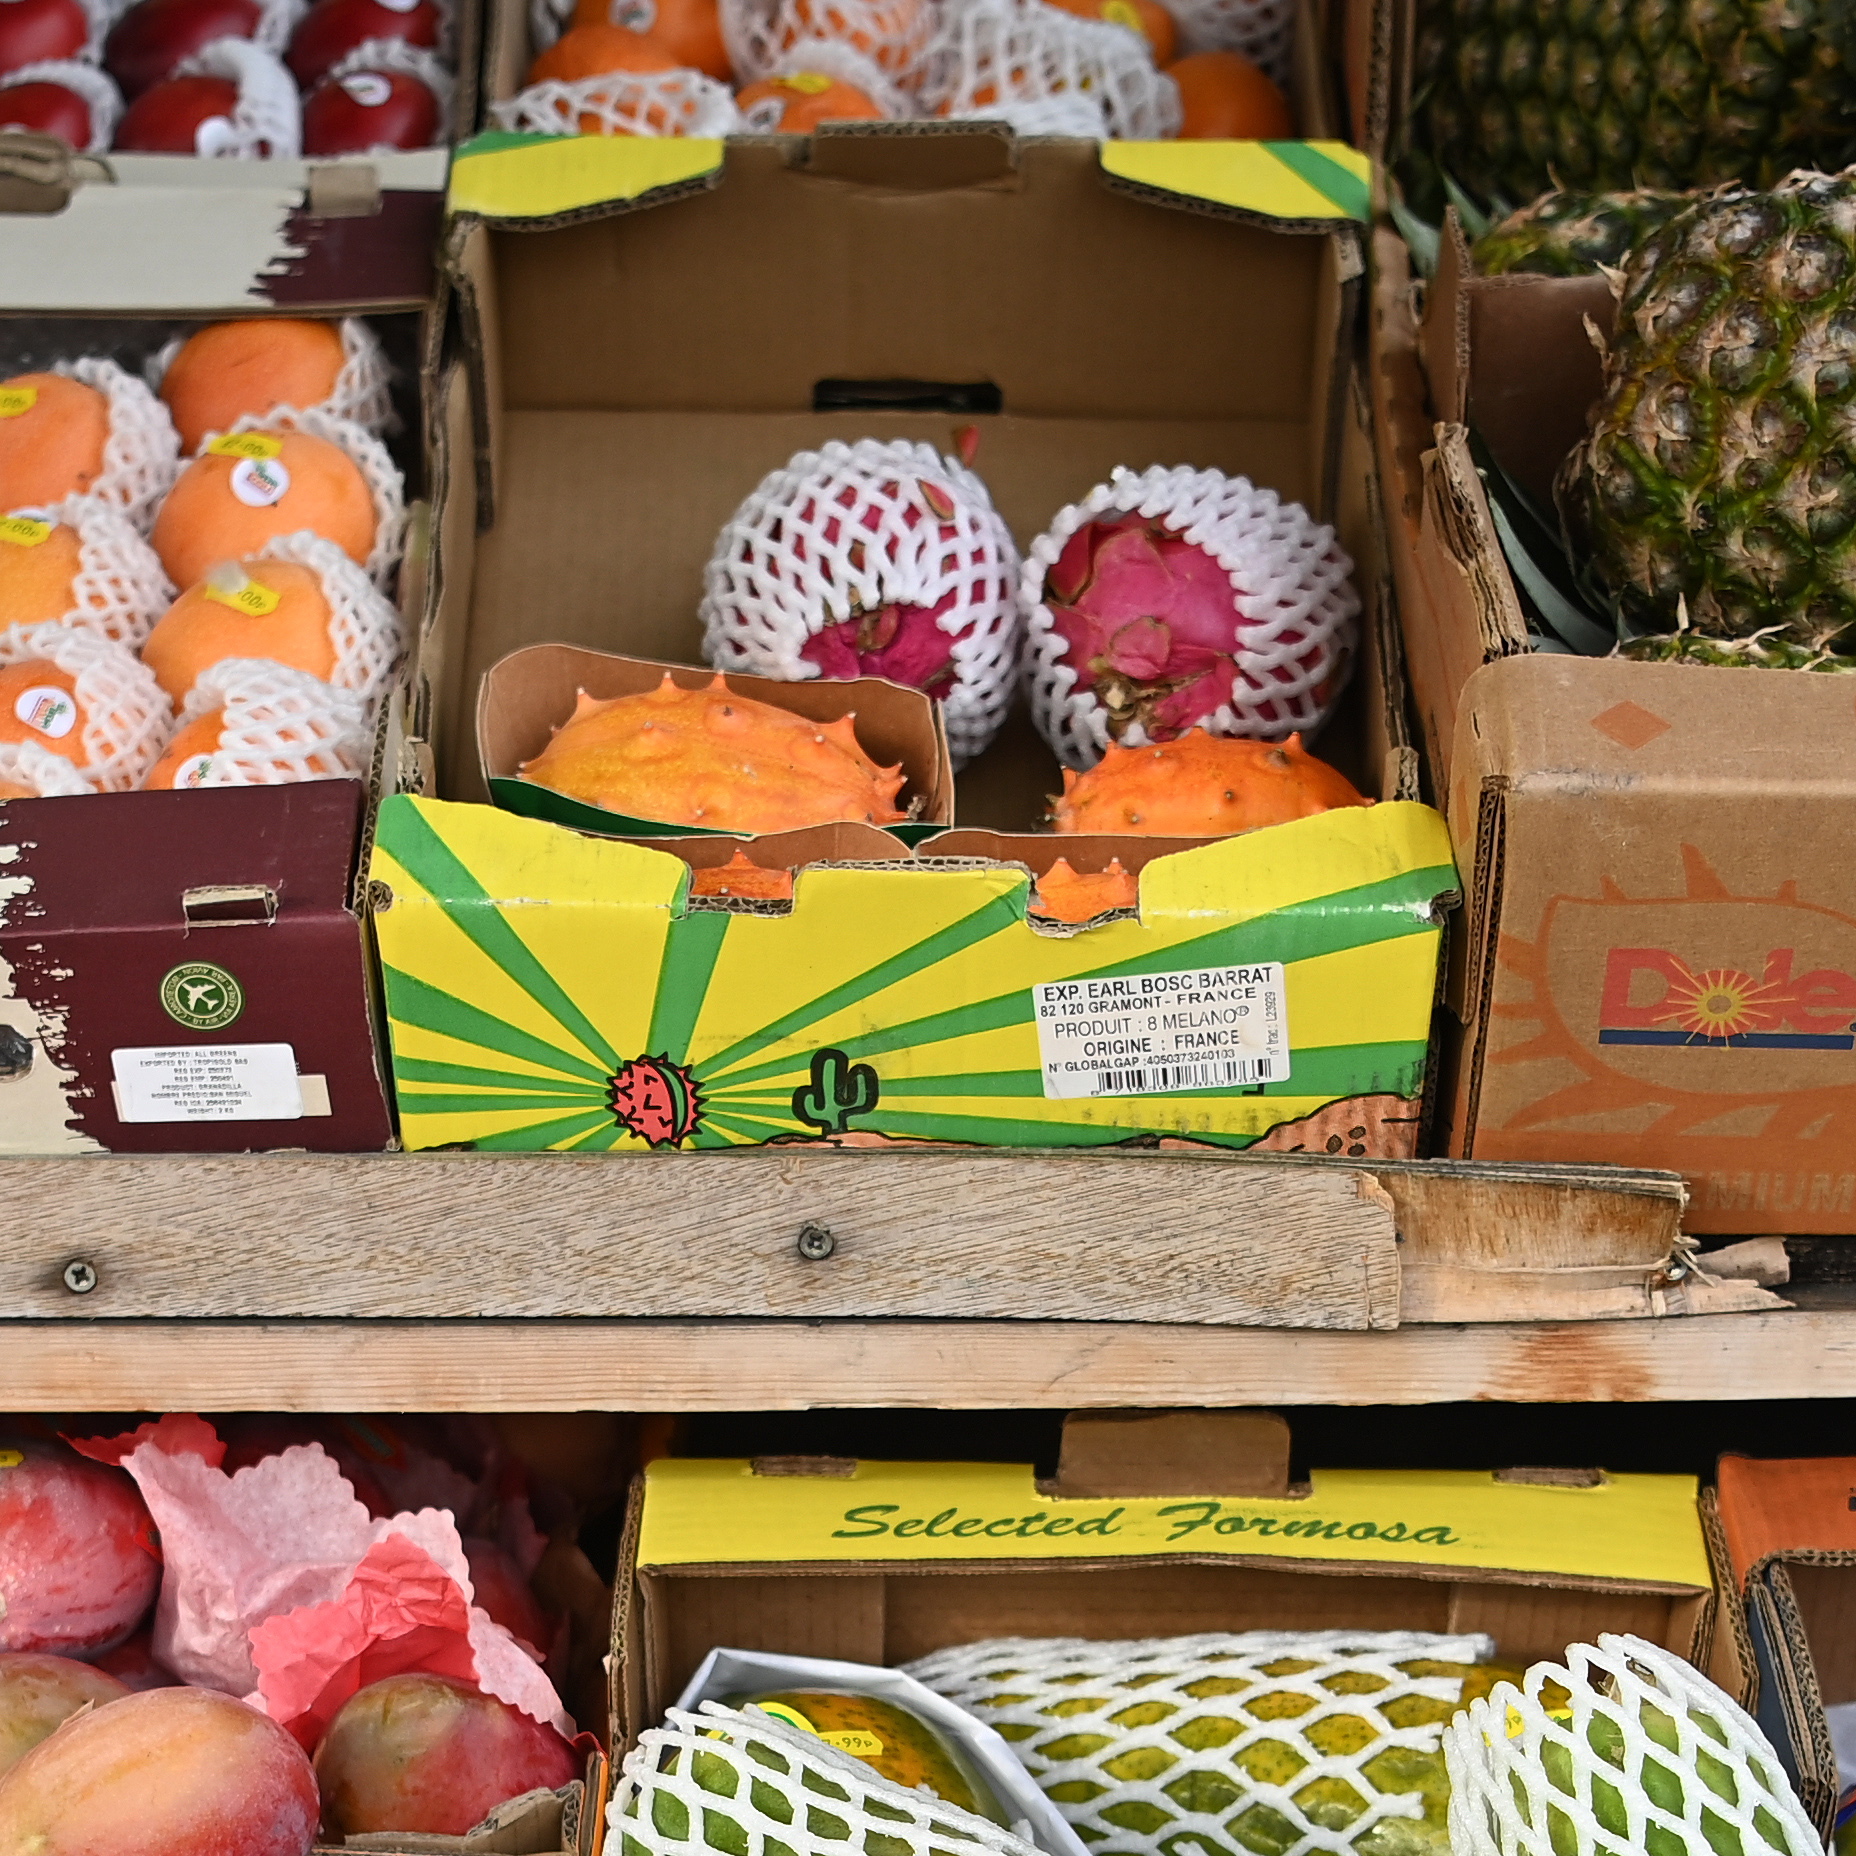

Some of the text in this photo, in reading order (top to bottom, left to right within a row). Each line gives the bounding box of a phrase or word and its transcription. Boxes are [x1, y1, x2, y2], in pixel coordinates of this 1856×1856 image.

[1044, 967, 1273, 1002] EXP. EARL BOSC BARRAT
[1041, 986, 1257, 1017] 82 120 GRAMONT FRANCE
[1055, 1016, 1158, 1039] PRODUIT 8
[1083, 1029, 1240, 1057] ORIGINE FRANCE
[832, 1502, 1460, 1547] Selected Formosa
